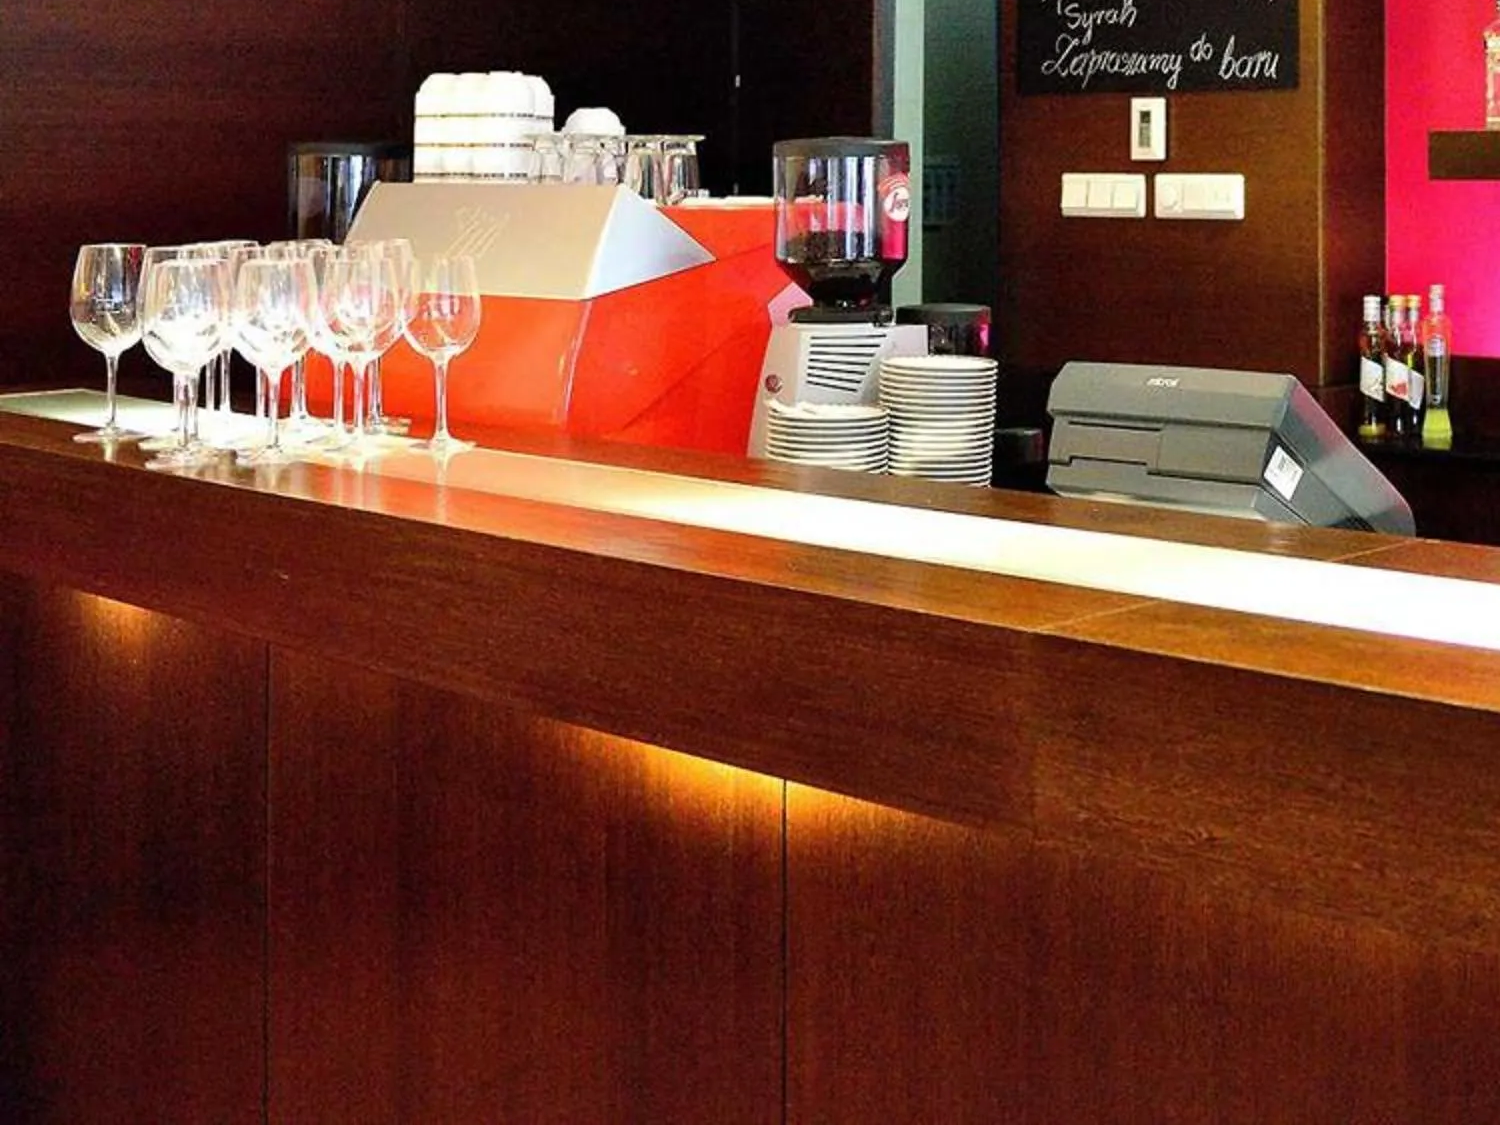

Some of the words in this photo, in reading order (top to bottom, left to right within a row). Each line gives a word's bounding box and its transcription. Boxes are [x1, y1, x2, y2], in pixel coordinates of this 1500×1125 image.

[1065, 3, 1137, 45] Syrah
[1190, 31, 1213, 61] do
[1219, 35, 1279, 80] baru
